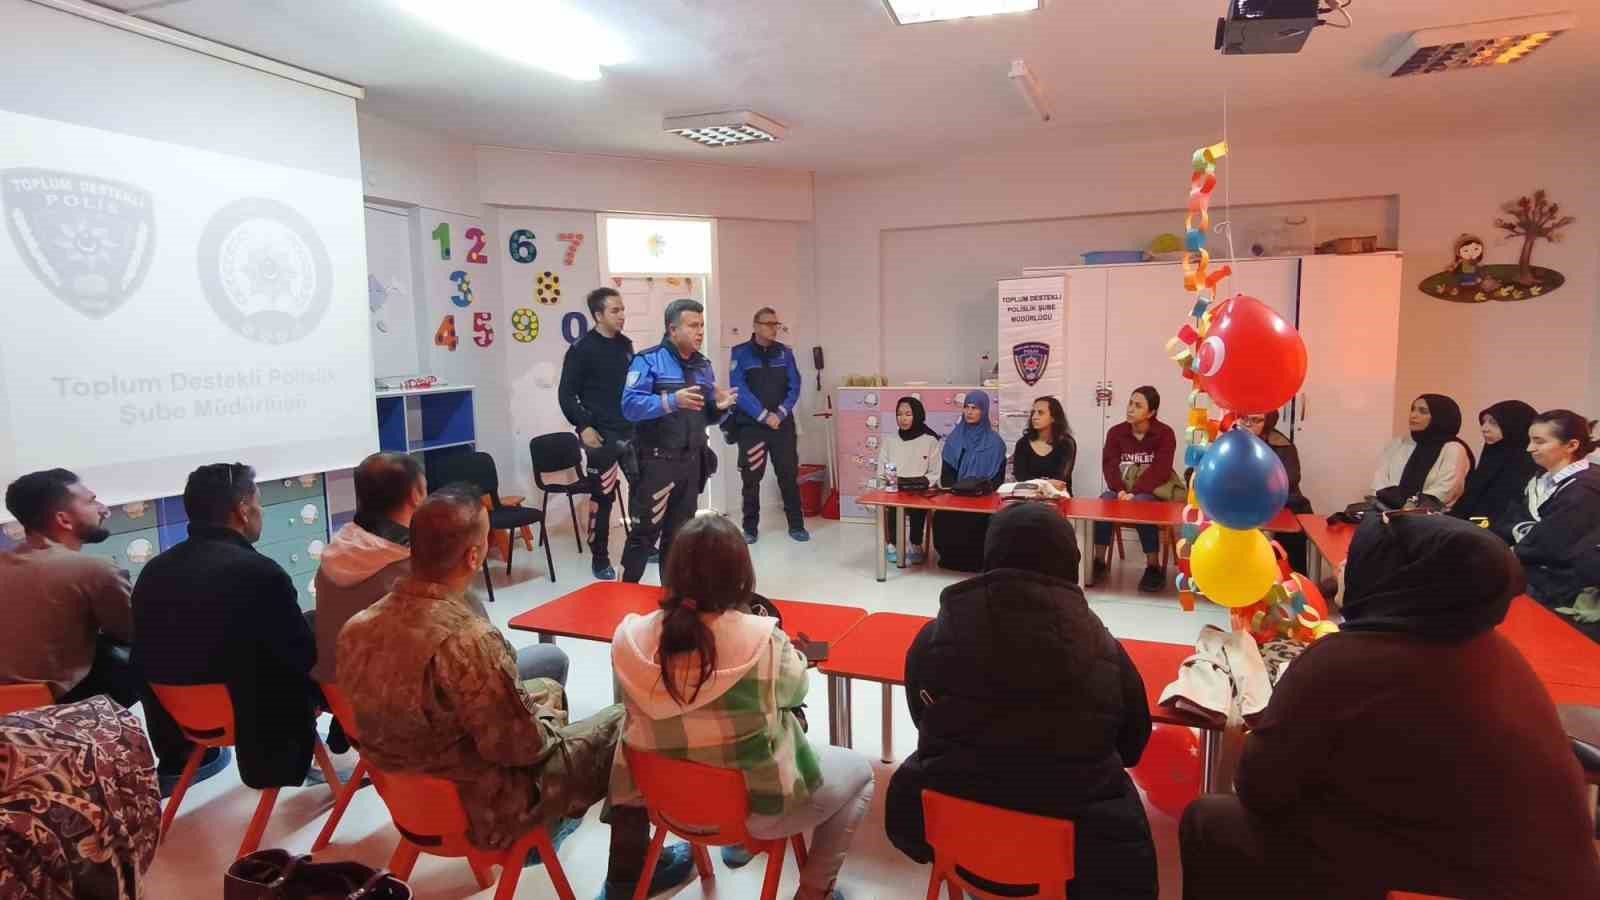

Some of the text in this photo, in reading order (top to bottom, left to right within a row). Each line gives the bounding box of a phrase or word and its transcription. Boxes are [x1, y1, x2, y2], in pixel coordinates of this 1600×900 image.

[432, 223, 488, 264] 1 2
[509, 229, 584, 266] 6 7
[449, 271, 472, 308] 3
[536, 271, 561, 305] 8
[435, 312, 494, 352] 4 5
[512, 308, 539, 343] 9
[50, 375, 161, 399] Toplum
[170, 370, 261, 392] Destekli
[120, 402, 186, 425] Şube
